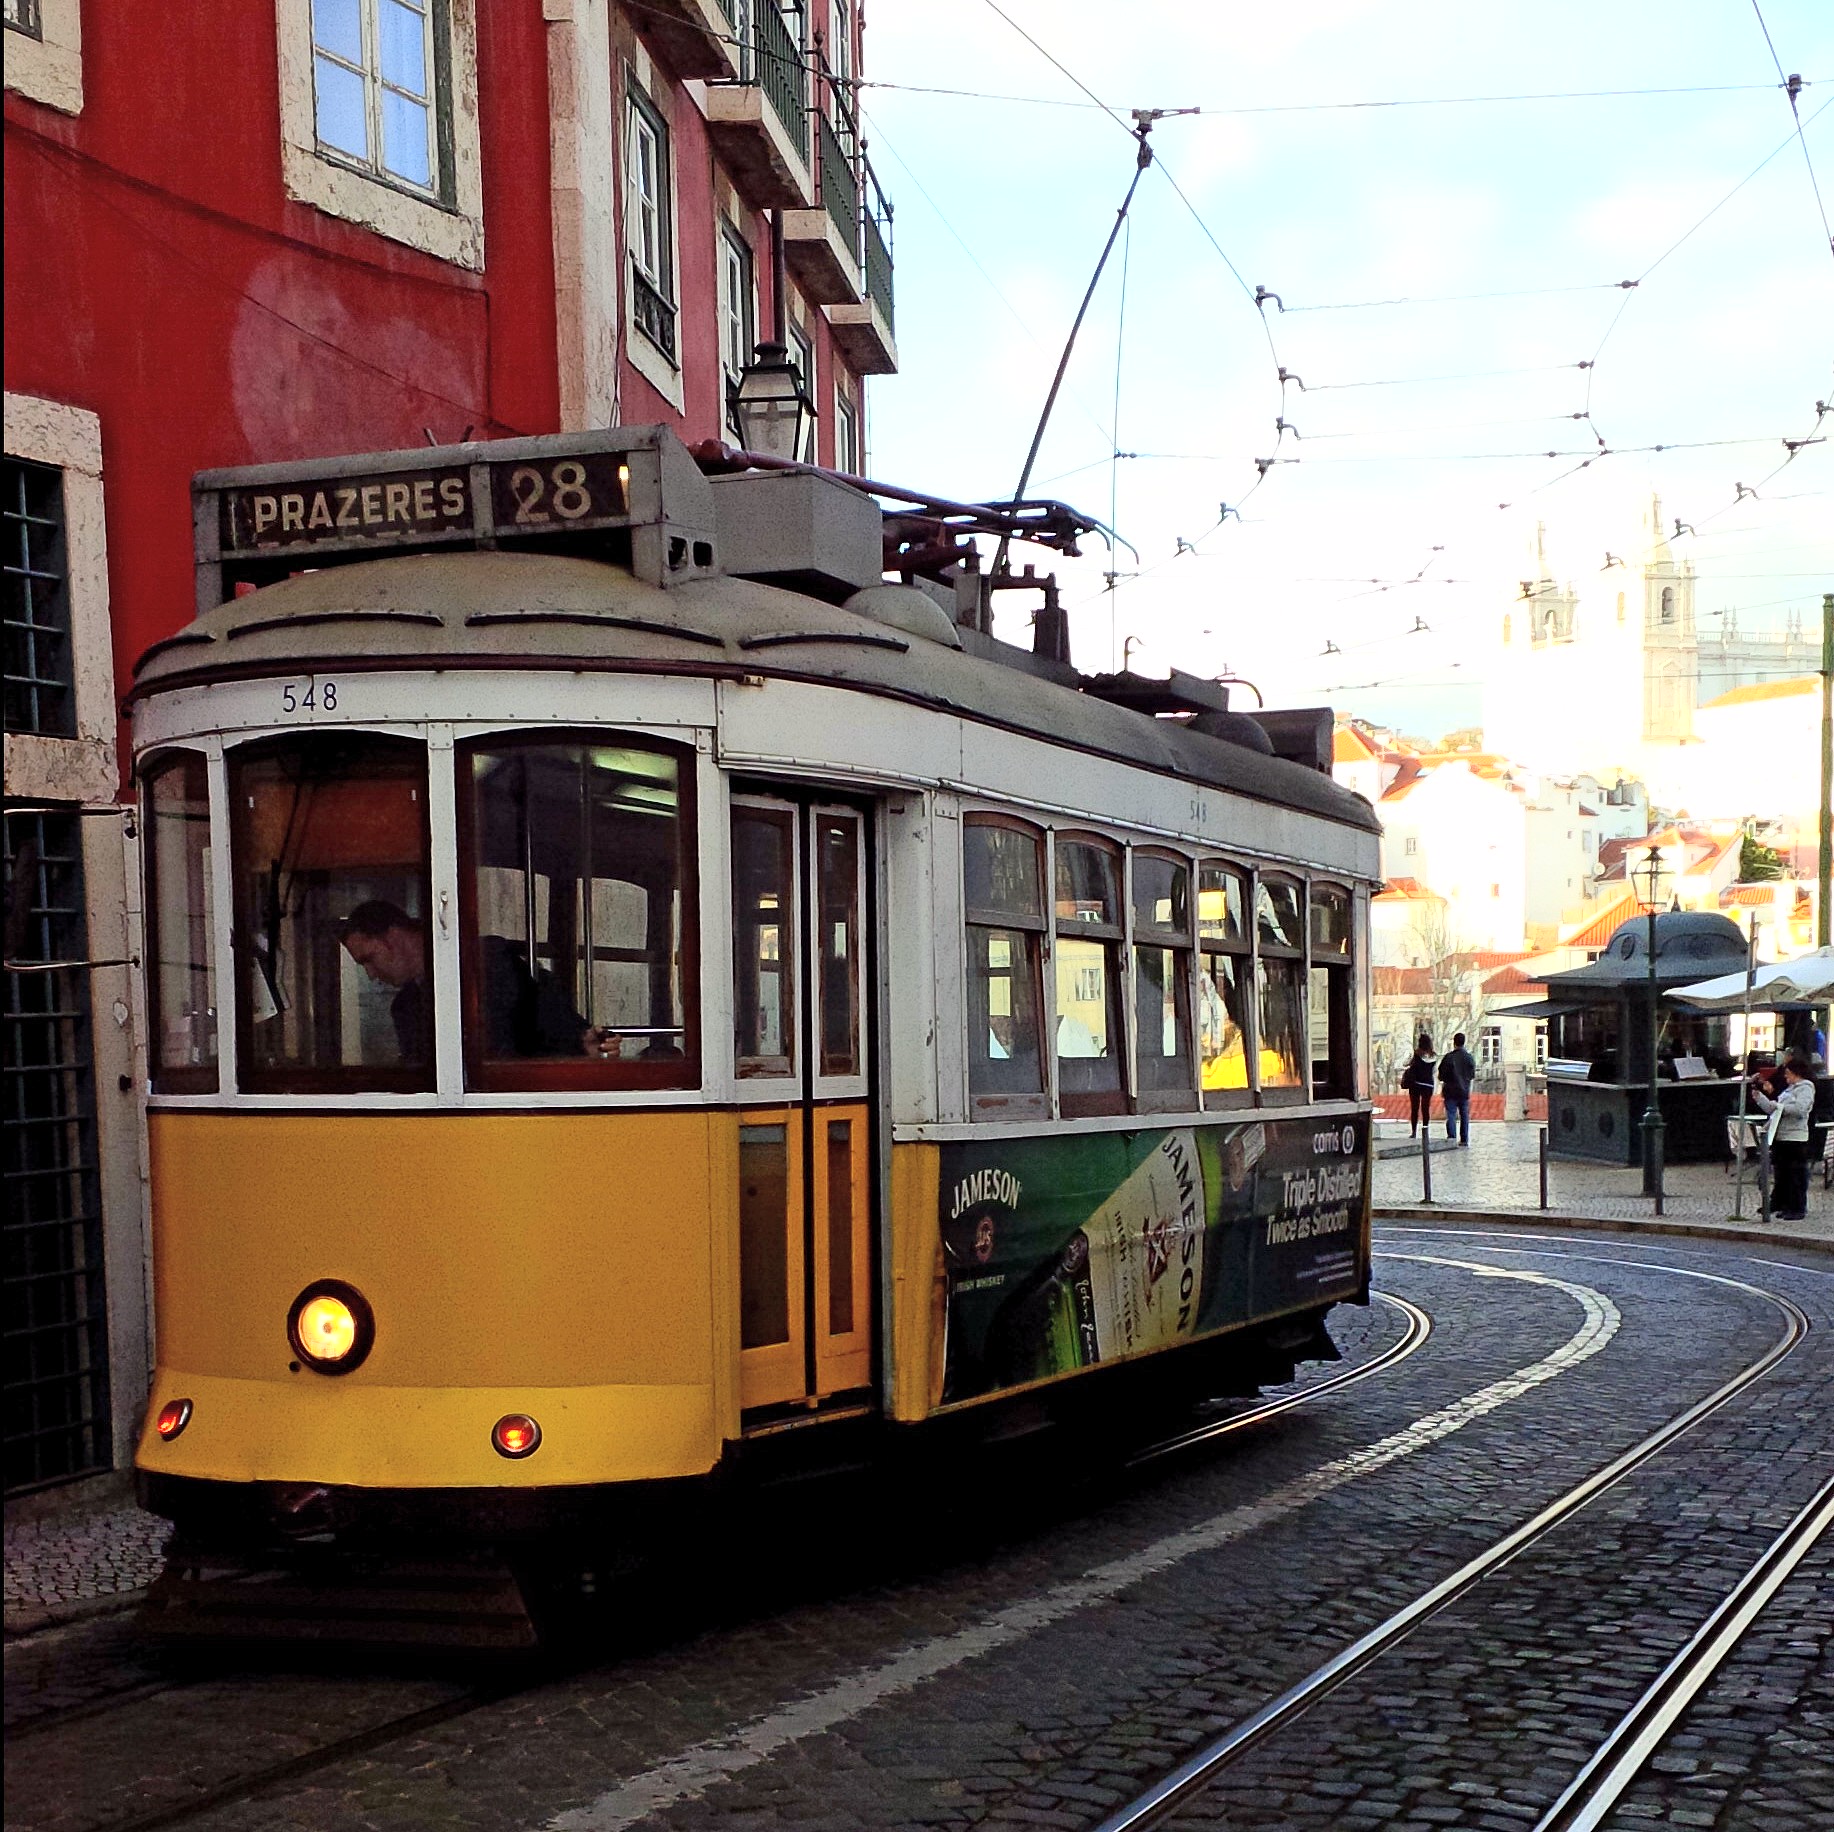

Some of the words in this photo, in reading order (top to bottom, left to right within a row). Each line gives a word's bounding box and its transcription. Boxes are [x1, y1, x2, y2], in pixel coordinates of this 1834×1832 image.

[253, 477, 465, 533] PRAZERES
[511, 460, 592, 523] 28
[282, 682, 338, 713] 548
[1190, 800, 1208, 823] 548
[951, 1169, 1021, 1219] JAMESON
[1283, 1168, 1317, 1214] Triple
[1318, 1160, 1363, 1203] Distilled
[1162, 1136, 1197, 1333] JAMESON
[1266, 1211, 1297, 1246] Twice
[1298, 1214, 1311, 1239] as
[1311, 1202, 1350, 1236] Smooth
